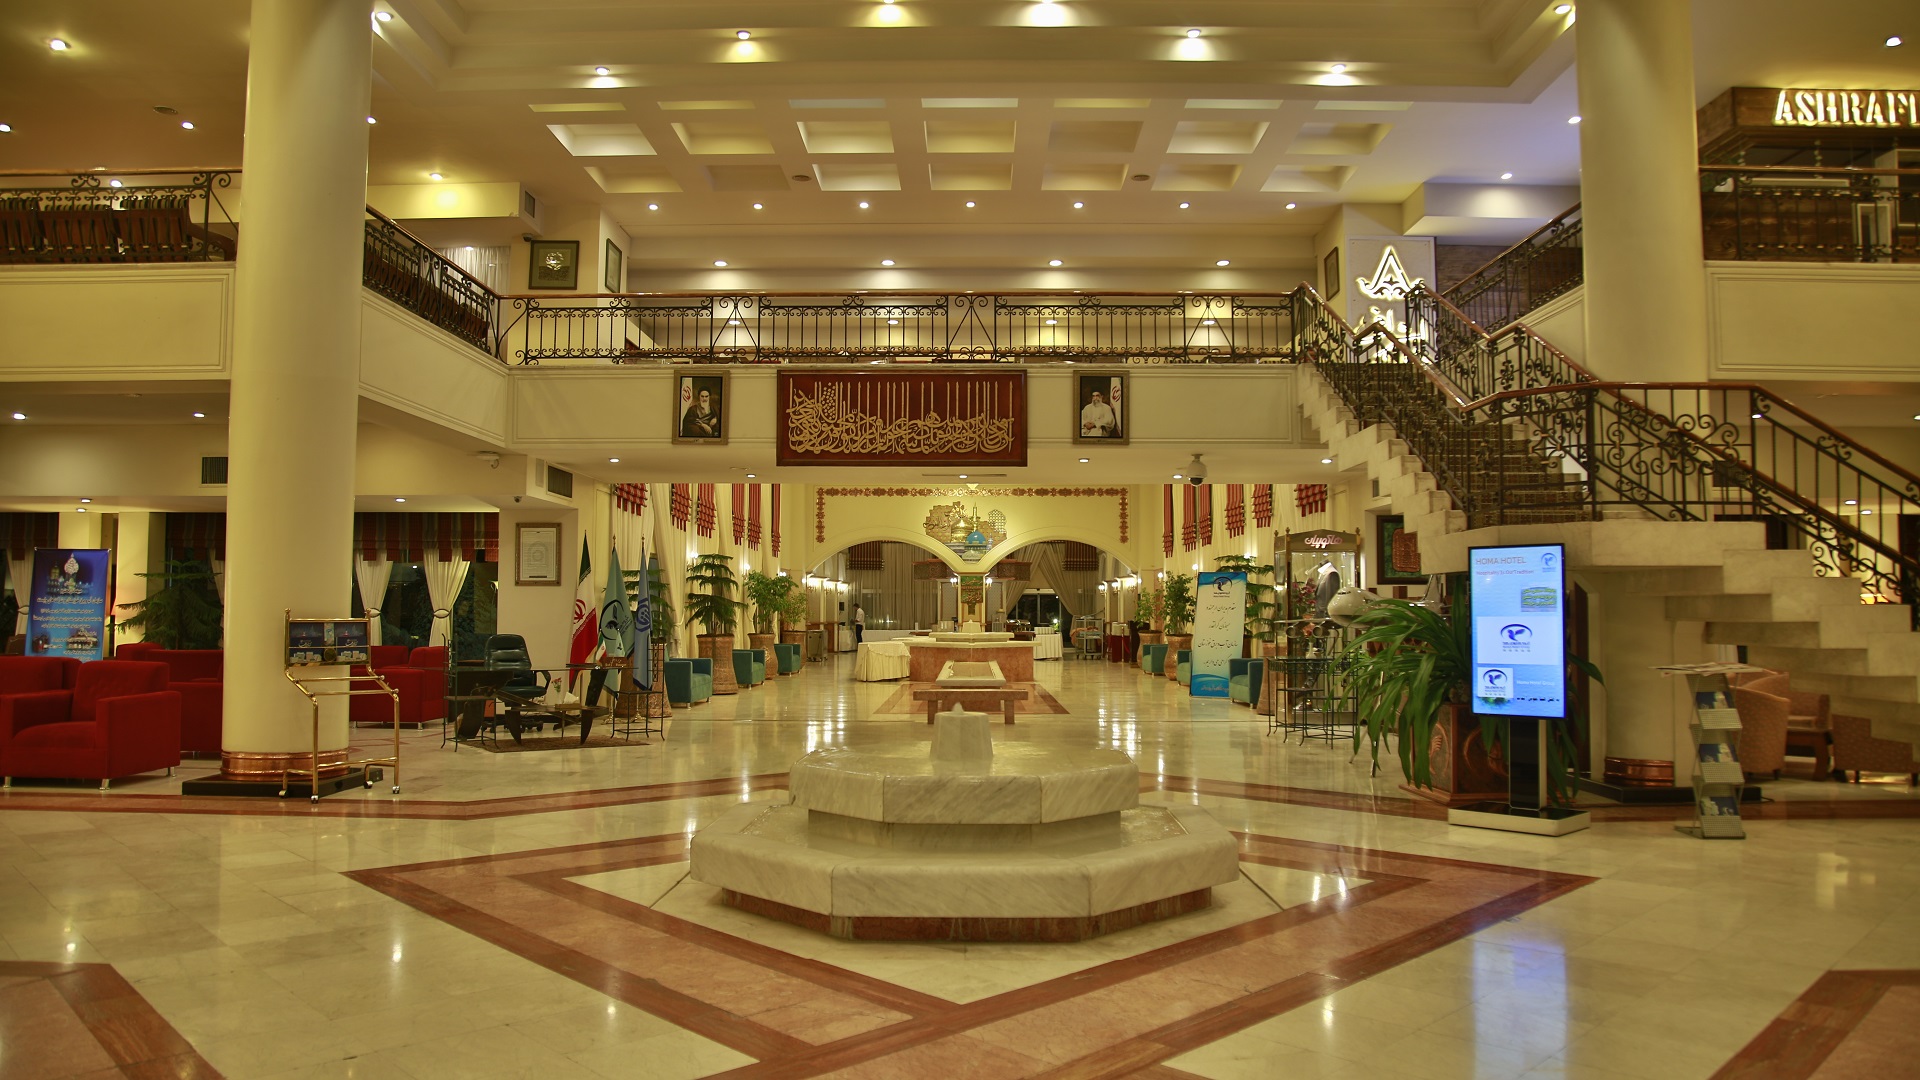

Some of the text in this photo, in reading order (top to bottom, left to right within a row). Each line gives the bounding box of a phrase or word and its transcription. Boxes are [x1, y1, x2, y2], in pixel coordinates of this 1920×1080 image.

[1773, 88, 1920, 127] ASHRAFI
[1476, 556, 1527, 565] HOMA HOTEL
